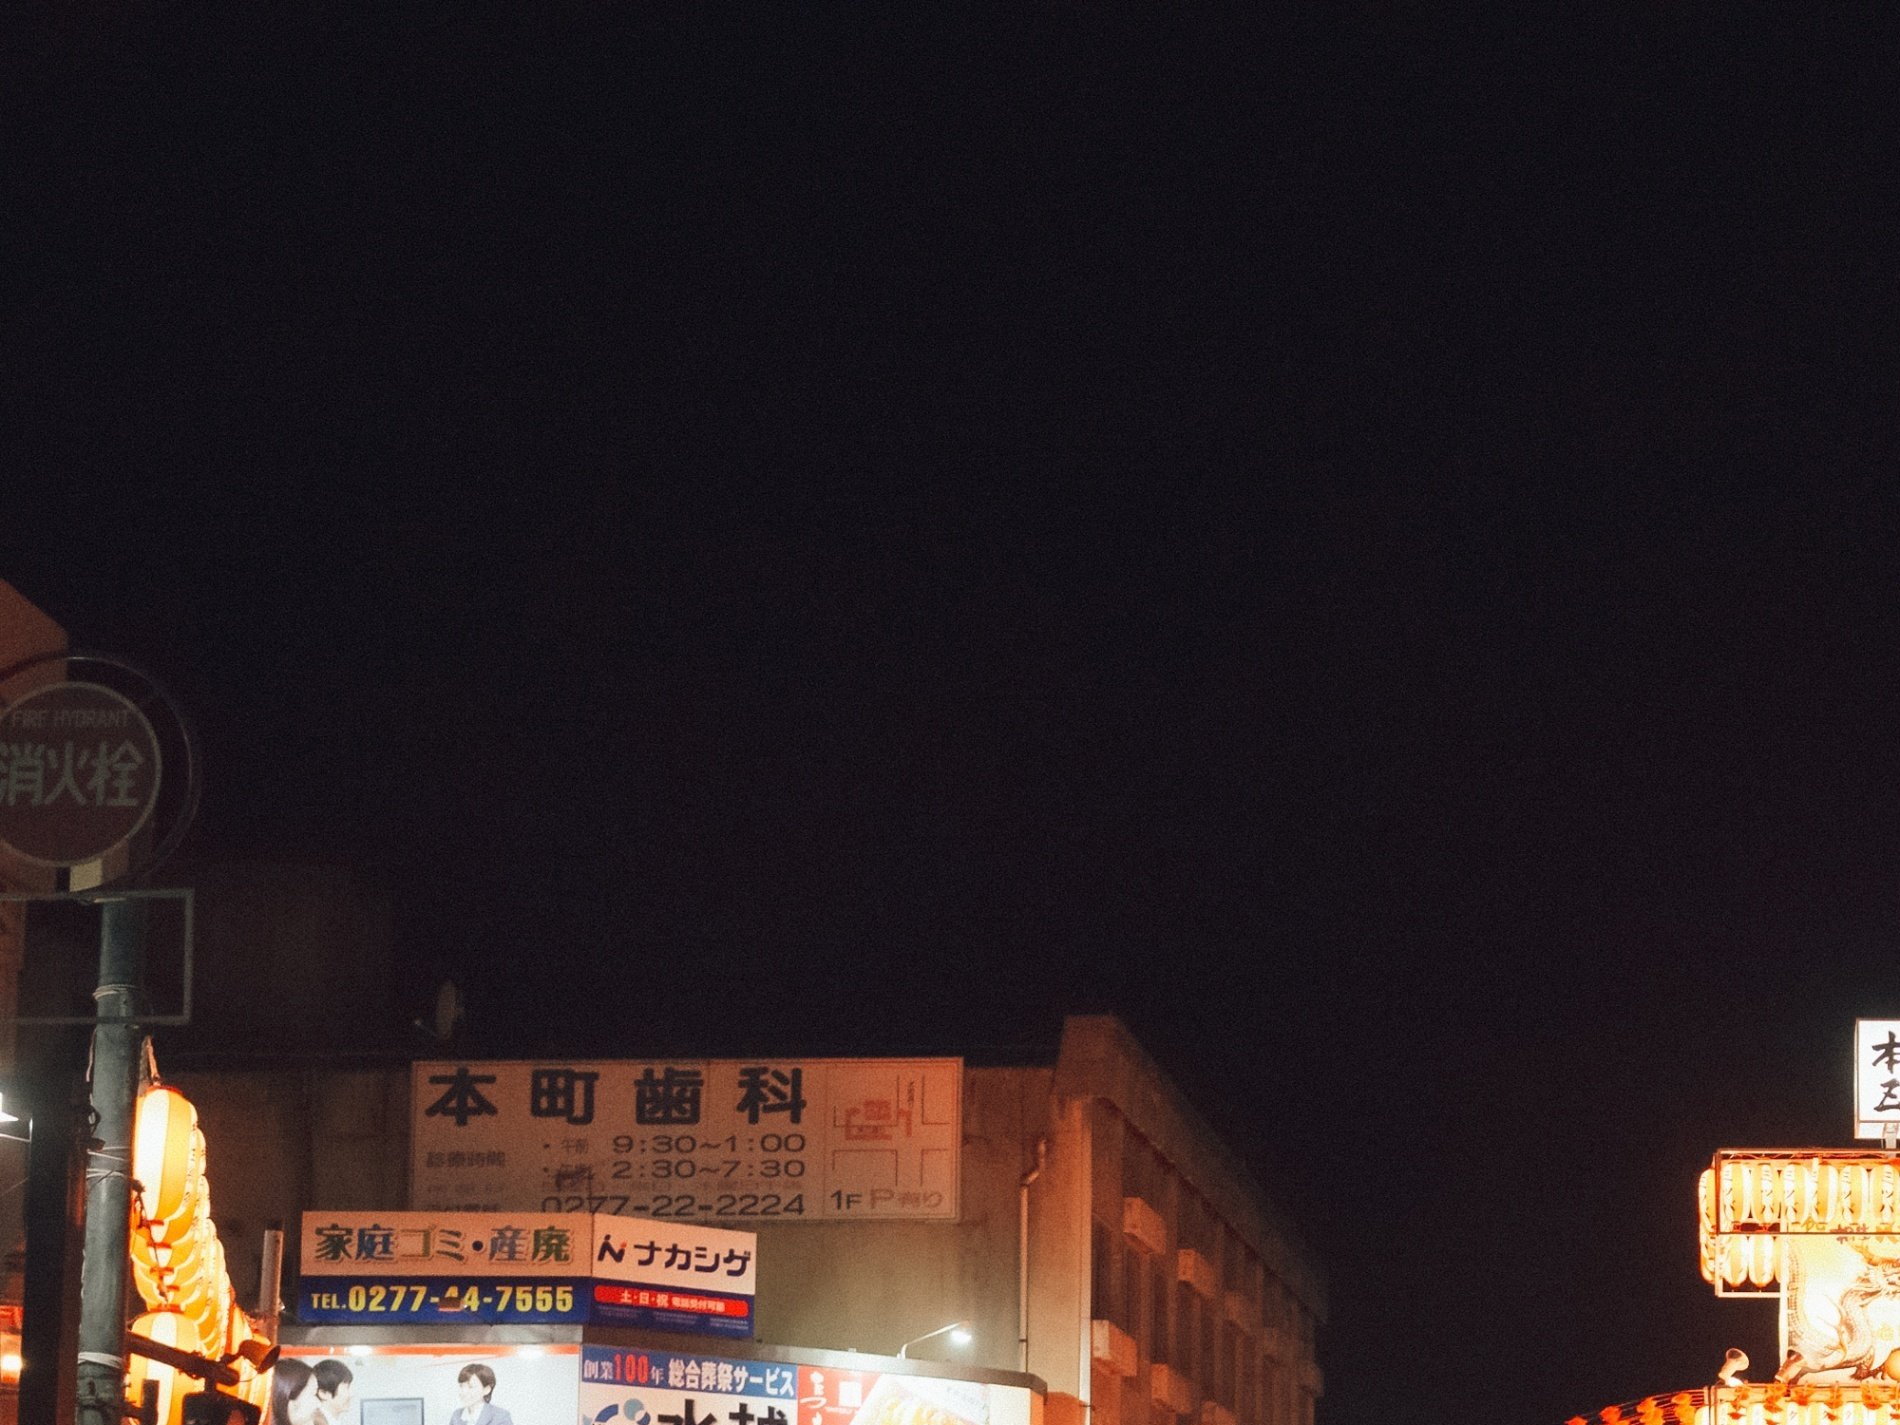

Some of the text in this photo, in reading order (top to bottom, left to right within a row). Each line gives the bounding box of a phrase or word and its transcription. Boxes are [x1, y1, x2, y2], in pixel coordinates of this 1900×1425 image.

[0, 739, 144, 807] 消火栓
[424, 1065, 808, 1128] 本町歯科
[541, 1193, 807, 1217] 0277-22-2224
[314, 1224, 572, 1263] 家庭ゴミ・産廃
[633, 1240, 751, 1278] ナカシゲ
[667, 1357, 796, 1398] 総合葬祭サービス
